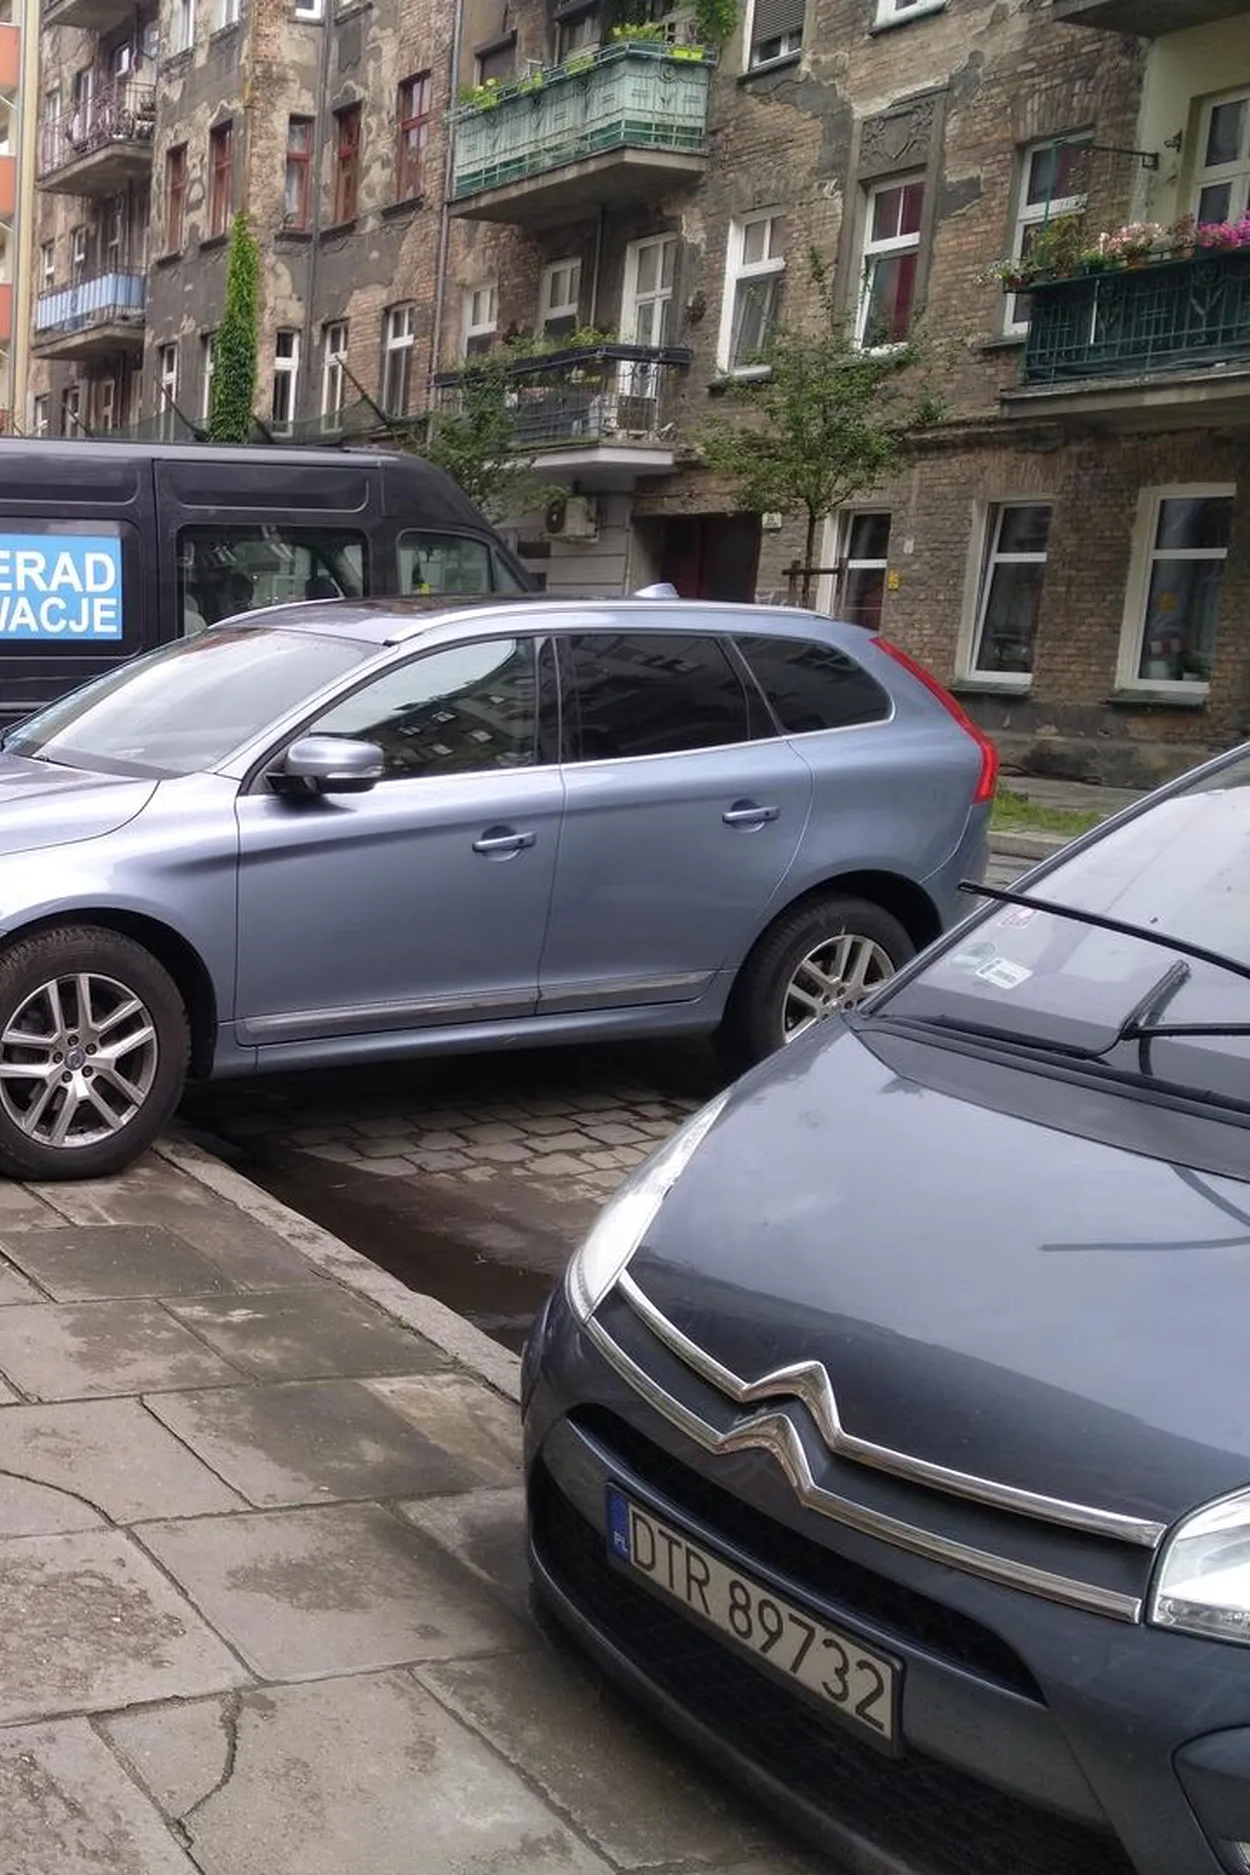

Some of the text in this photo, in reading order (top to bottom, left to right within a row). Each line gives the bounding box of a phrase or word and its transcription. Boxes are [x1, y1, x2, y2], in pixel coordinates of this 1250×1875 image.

[613, 1531, 628, 1553] PL
[632, 1510, 885, 1732] DTR 89732
